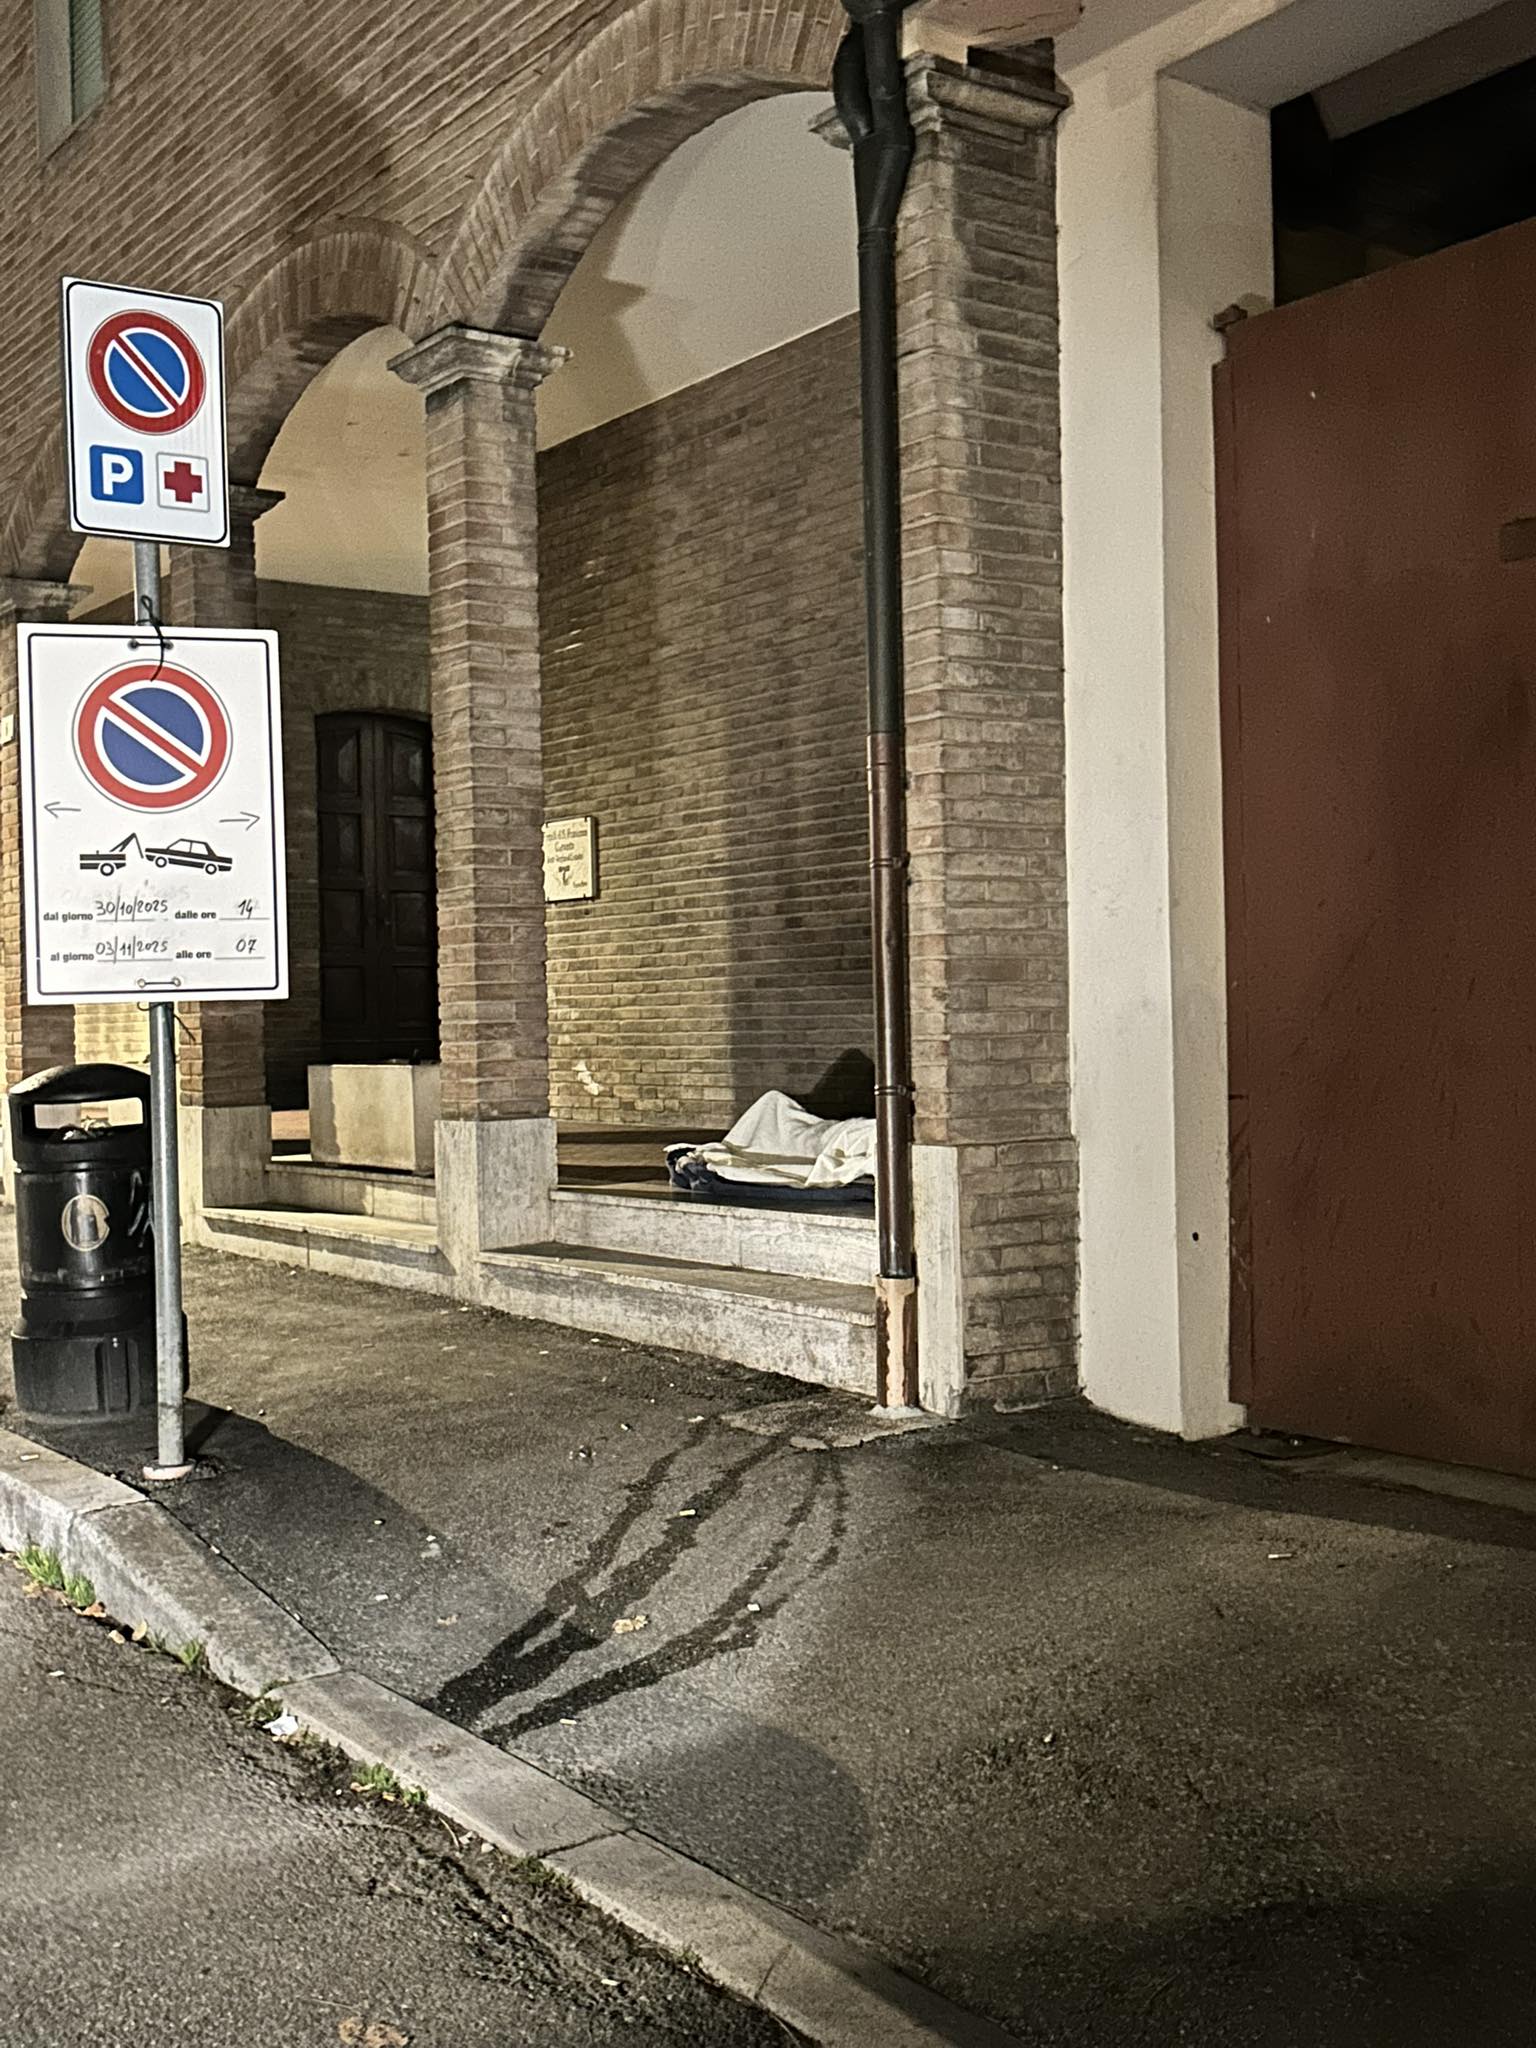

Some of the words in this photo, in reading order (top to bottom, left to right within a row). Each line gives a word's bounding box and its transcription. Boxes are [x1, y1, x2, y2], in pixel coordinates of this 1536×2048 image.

[101, 453, 133, 495] P
[43, 912, 59, 921] dal
[61, 911, 94, 922] giorno
[95, 894, 169, 922] 30/10/2025
[174, 909, 198, 920] dalle
[201, 911, 217, 919] ore
[237, 899, 256, 920] 14
[50, 951, 60, 961] al
[62, 952, 95, 963] giorno
[95, 936, 169, 964] 03/11/2025
[175, 950, 194, 960] alle
[196, 951, 213, 960] ore
[236, 938, 257, 954] 07
